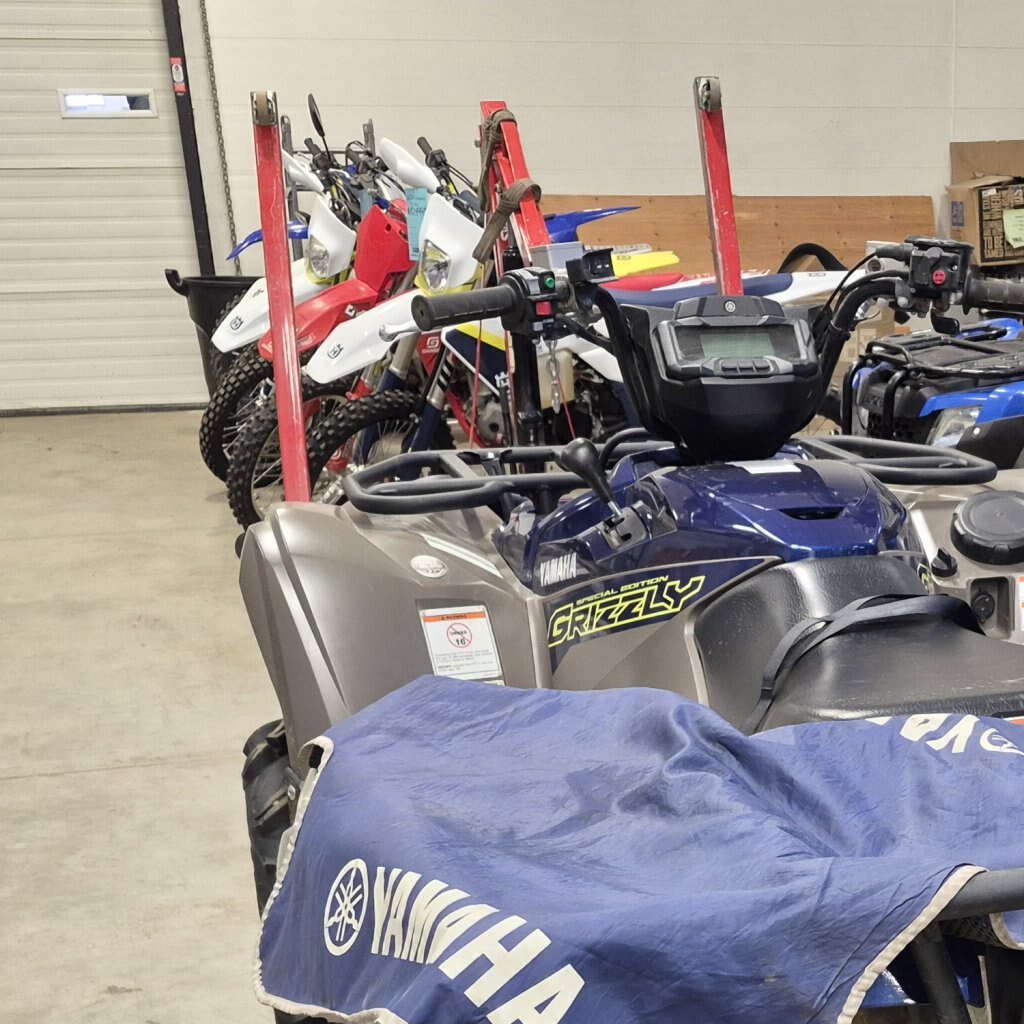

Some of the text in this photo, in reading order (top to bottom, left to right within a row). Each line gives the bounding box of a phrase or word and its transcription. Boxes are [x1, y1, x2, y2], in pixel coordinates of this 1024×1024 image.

[540, 552, 577, 587] YAMAHA
[576, 575, 669, 606] SPECIAL EDITION
[547, 575, 706, 648] GRIZZLY
